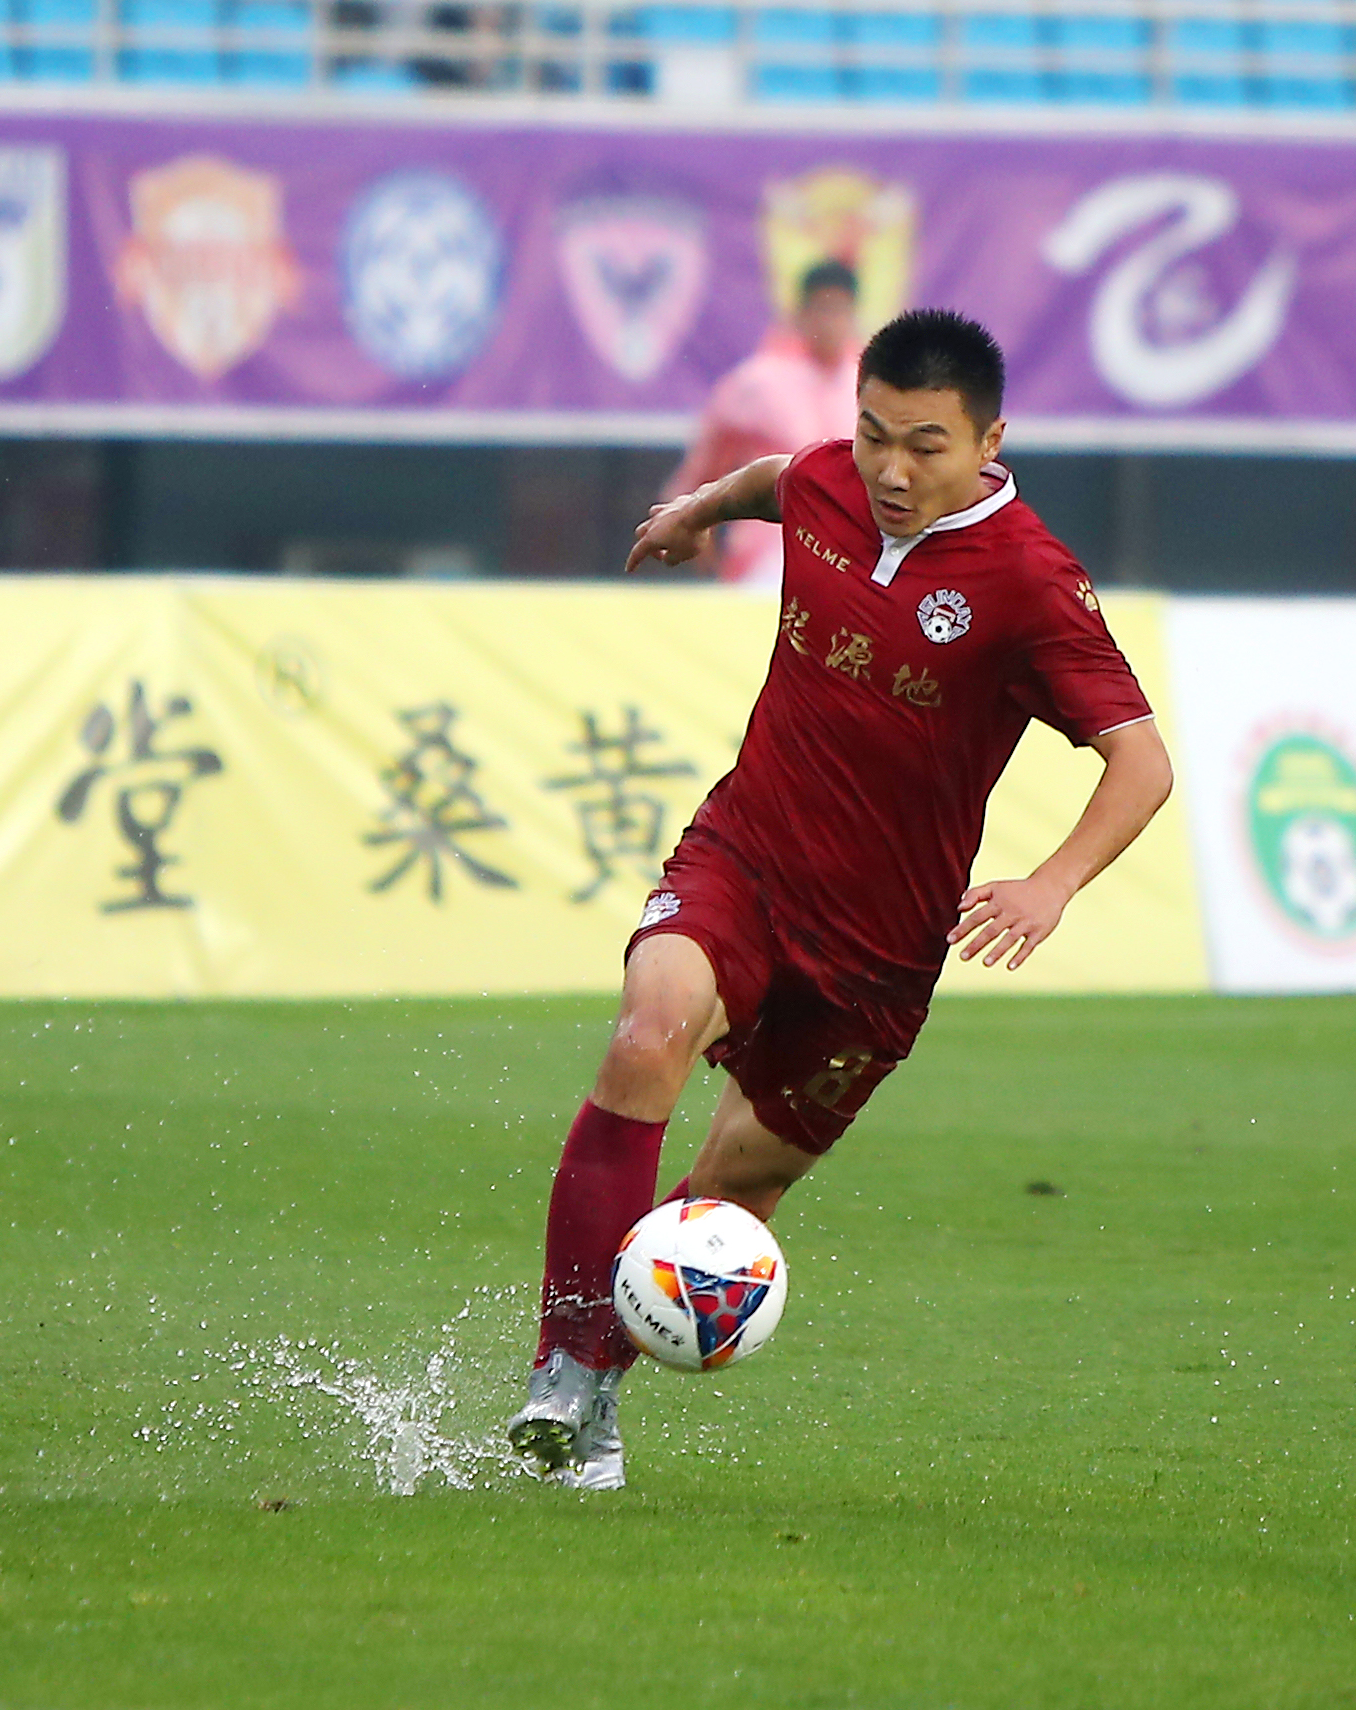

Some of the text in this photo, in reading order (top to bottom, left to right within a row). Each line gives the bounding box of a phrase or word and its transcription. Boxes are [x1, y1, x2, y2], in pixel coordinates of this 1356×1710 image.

[796, 526, 851, 572] KELME
[360, 702, 744, 906] 桑黄
[621, 1278, 673, 1340] KELME
